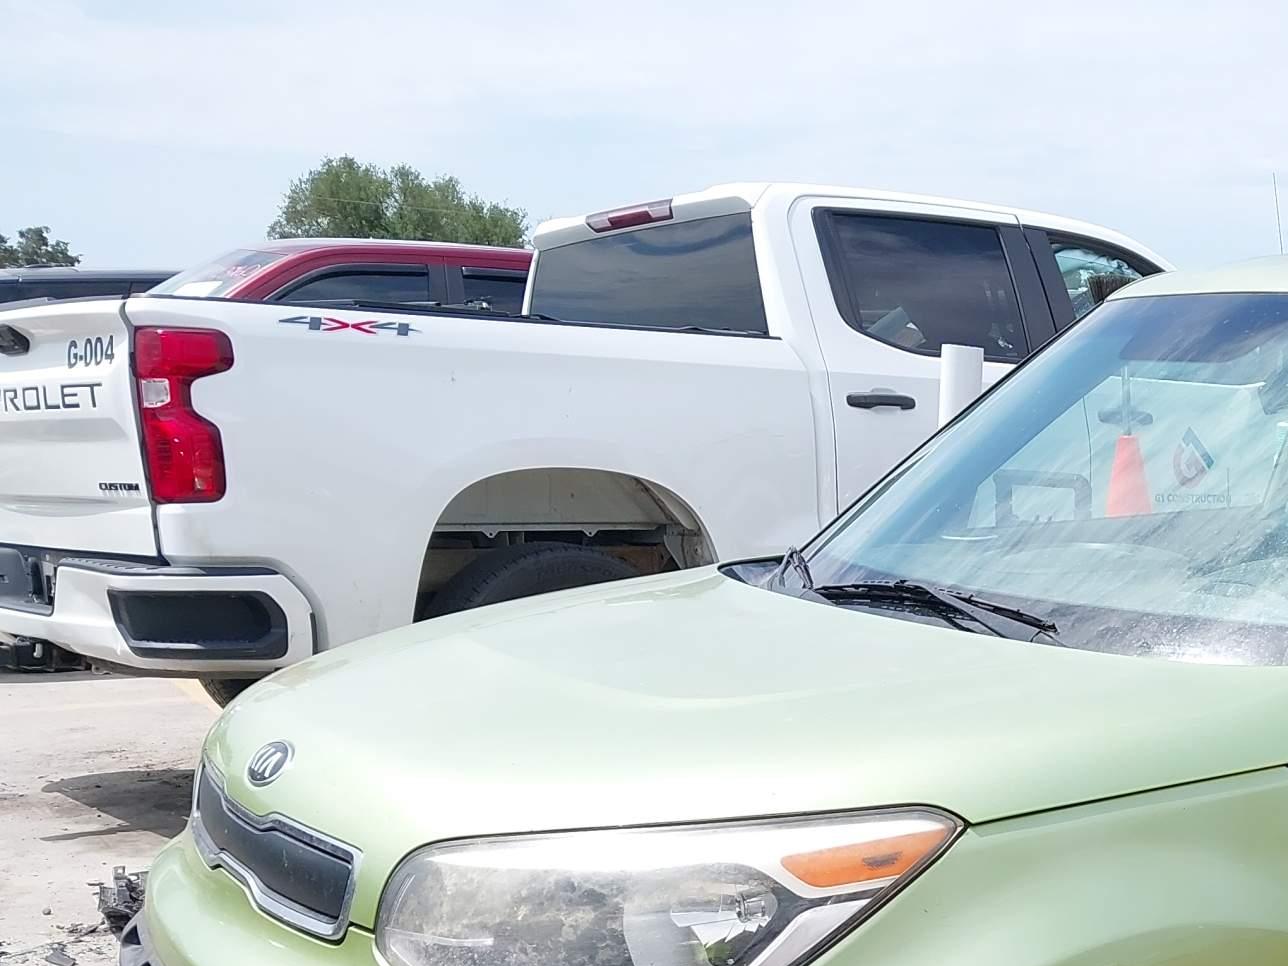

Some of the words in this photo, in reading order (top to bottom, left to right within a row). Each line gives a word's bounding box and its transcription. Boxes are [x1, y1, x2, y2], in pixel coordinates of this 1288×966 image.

[67, 334, 115, 369] G-004
[0, 382, 103, 412] ROLET
[98, 482, 140, 491] CUSTOM
